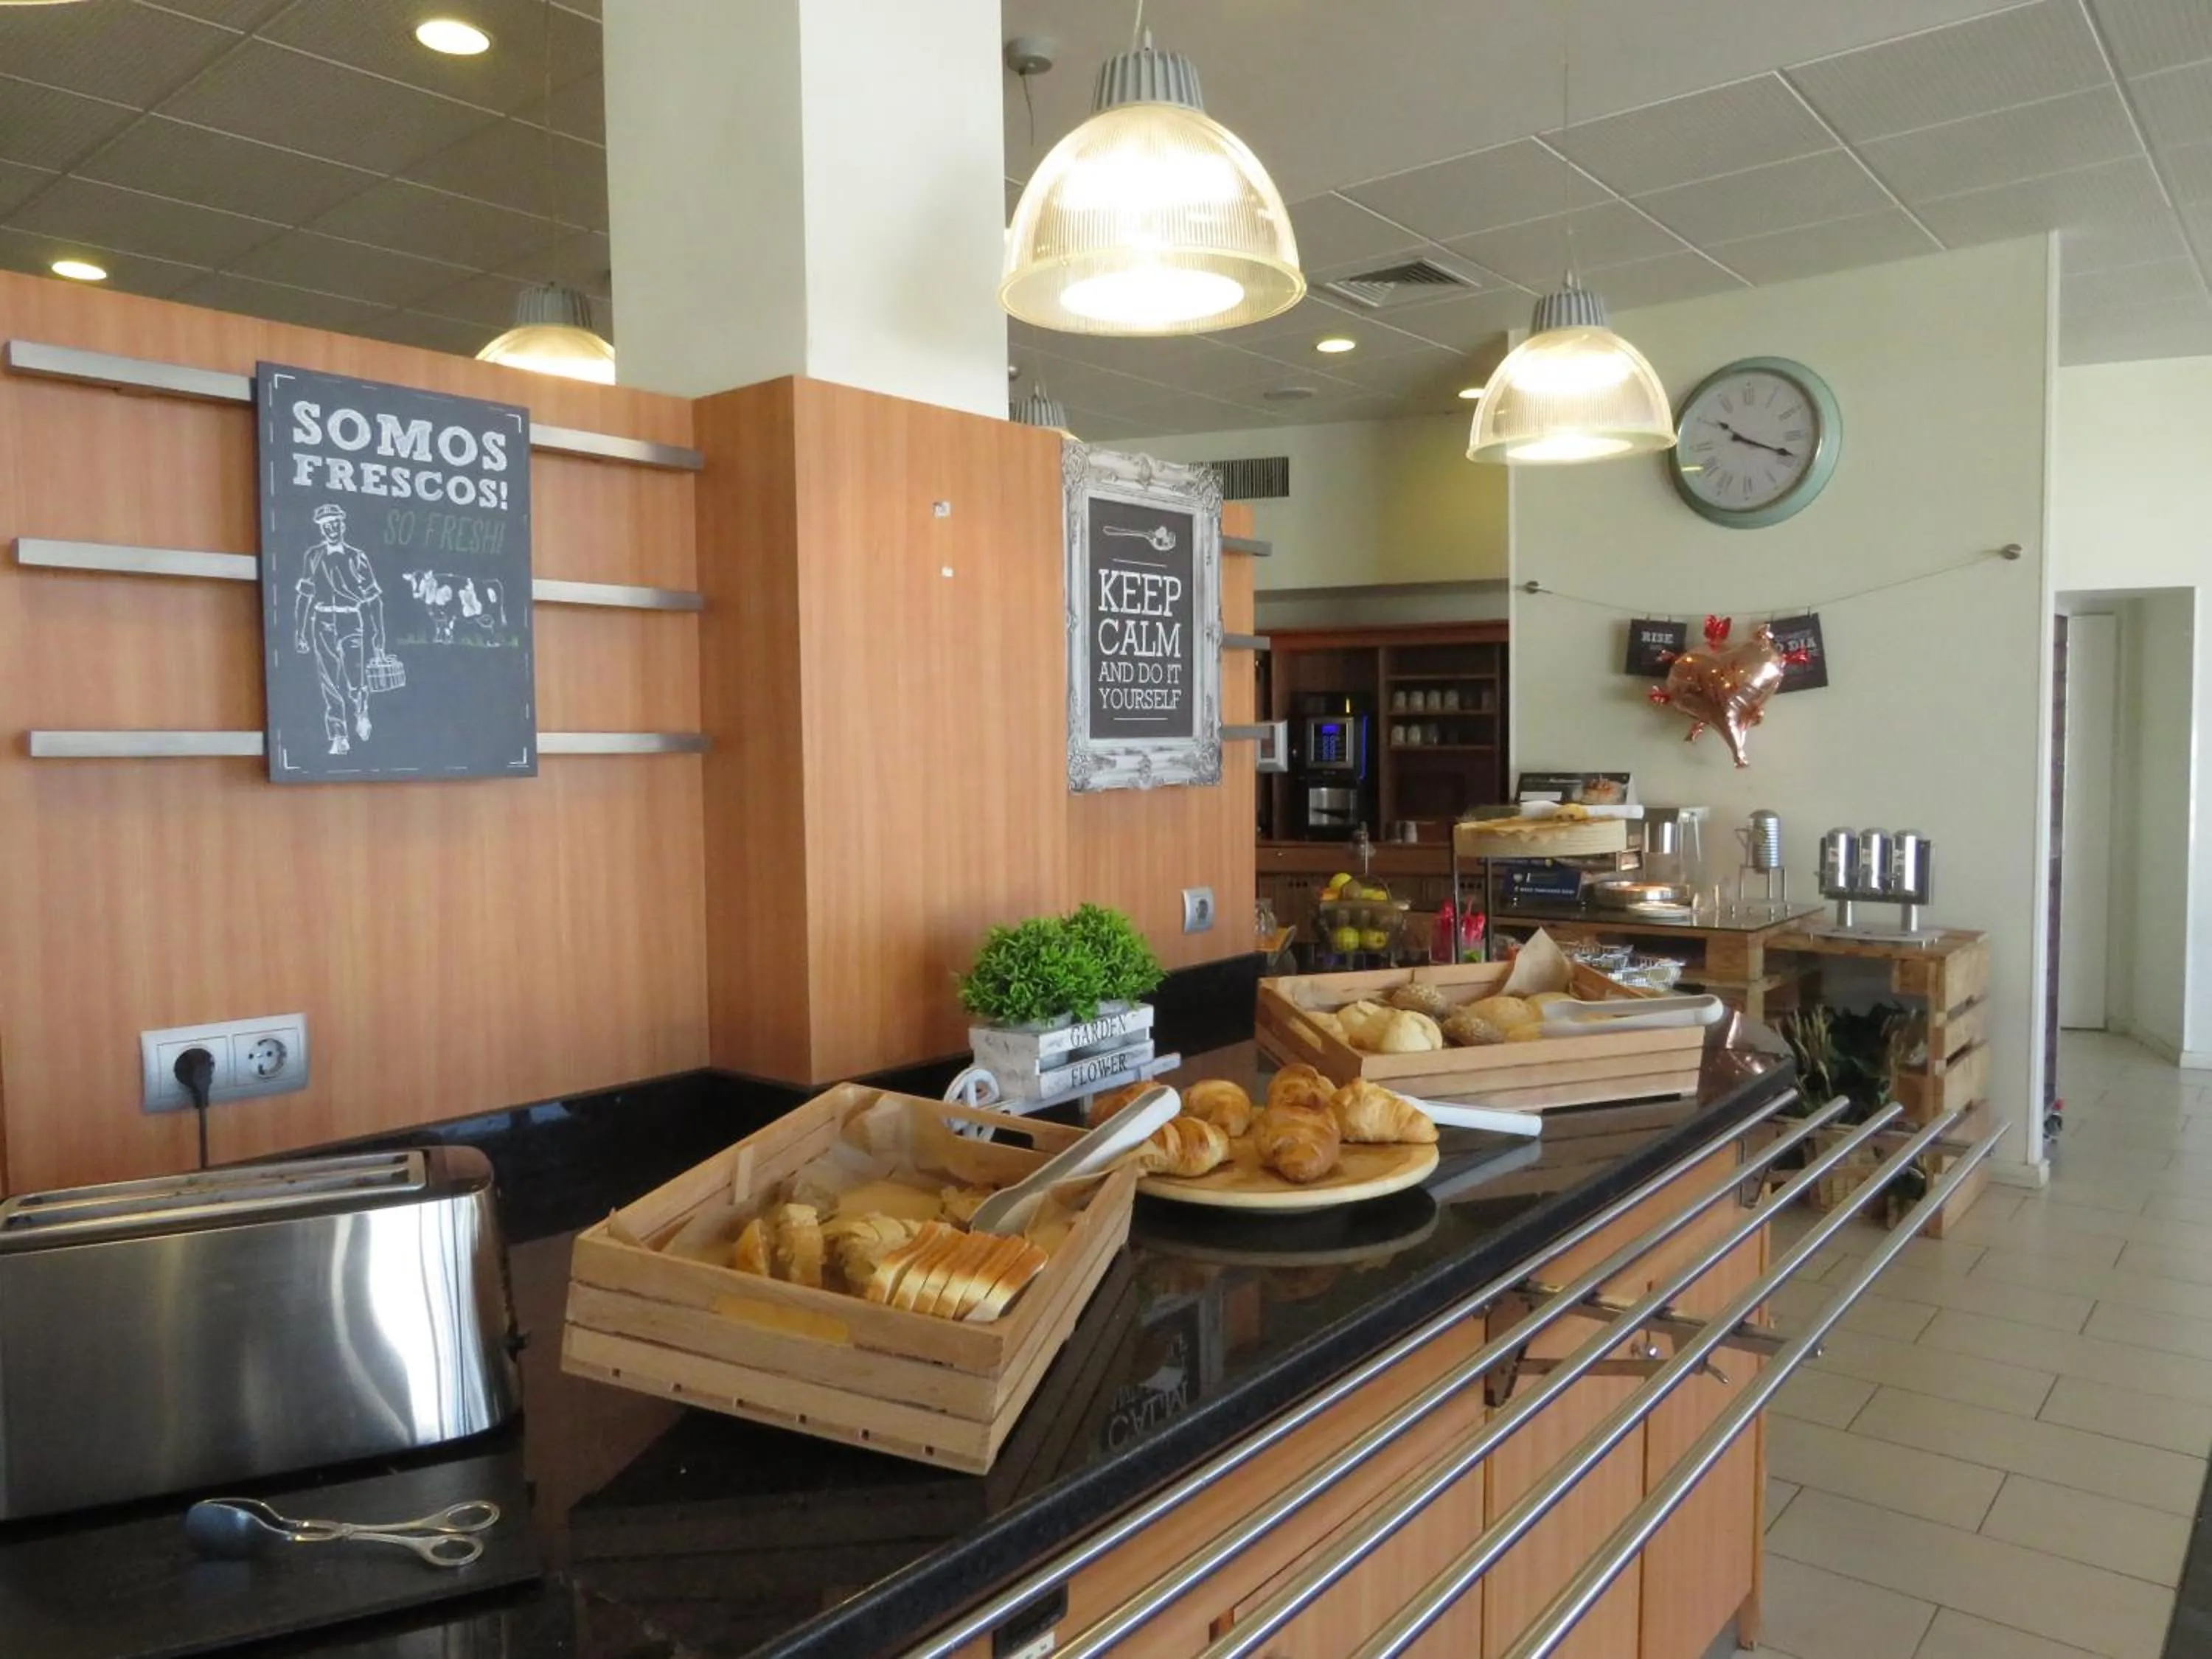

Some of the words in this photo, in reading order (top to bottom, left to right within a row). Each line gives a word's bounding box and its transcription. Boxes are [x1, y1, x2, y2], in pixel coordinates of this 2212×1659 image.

[292, 400, 507, 472] SOMOS
[292, 453, 508, 510] FRESCOS!
[383, 508, 415, 546] SO
[423, 511, 507, 556] FRESH!
[1098, 568, 1181, 617] KEEP
[1098, 619, 1181, 658] CALM
[1641, 631, 1674, 644] RISE
[1099, 661, 1134, 684] AND
[1138, 663, 1164, 684] DO
[1166, 664, 1181, 684] IT
[1099, 688, 1182, 711] YOURSELF
[1070, 1015, 1126, 1048] GARDEN
[1071, 1053, 1127, 1088] FLOWER
